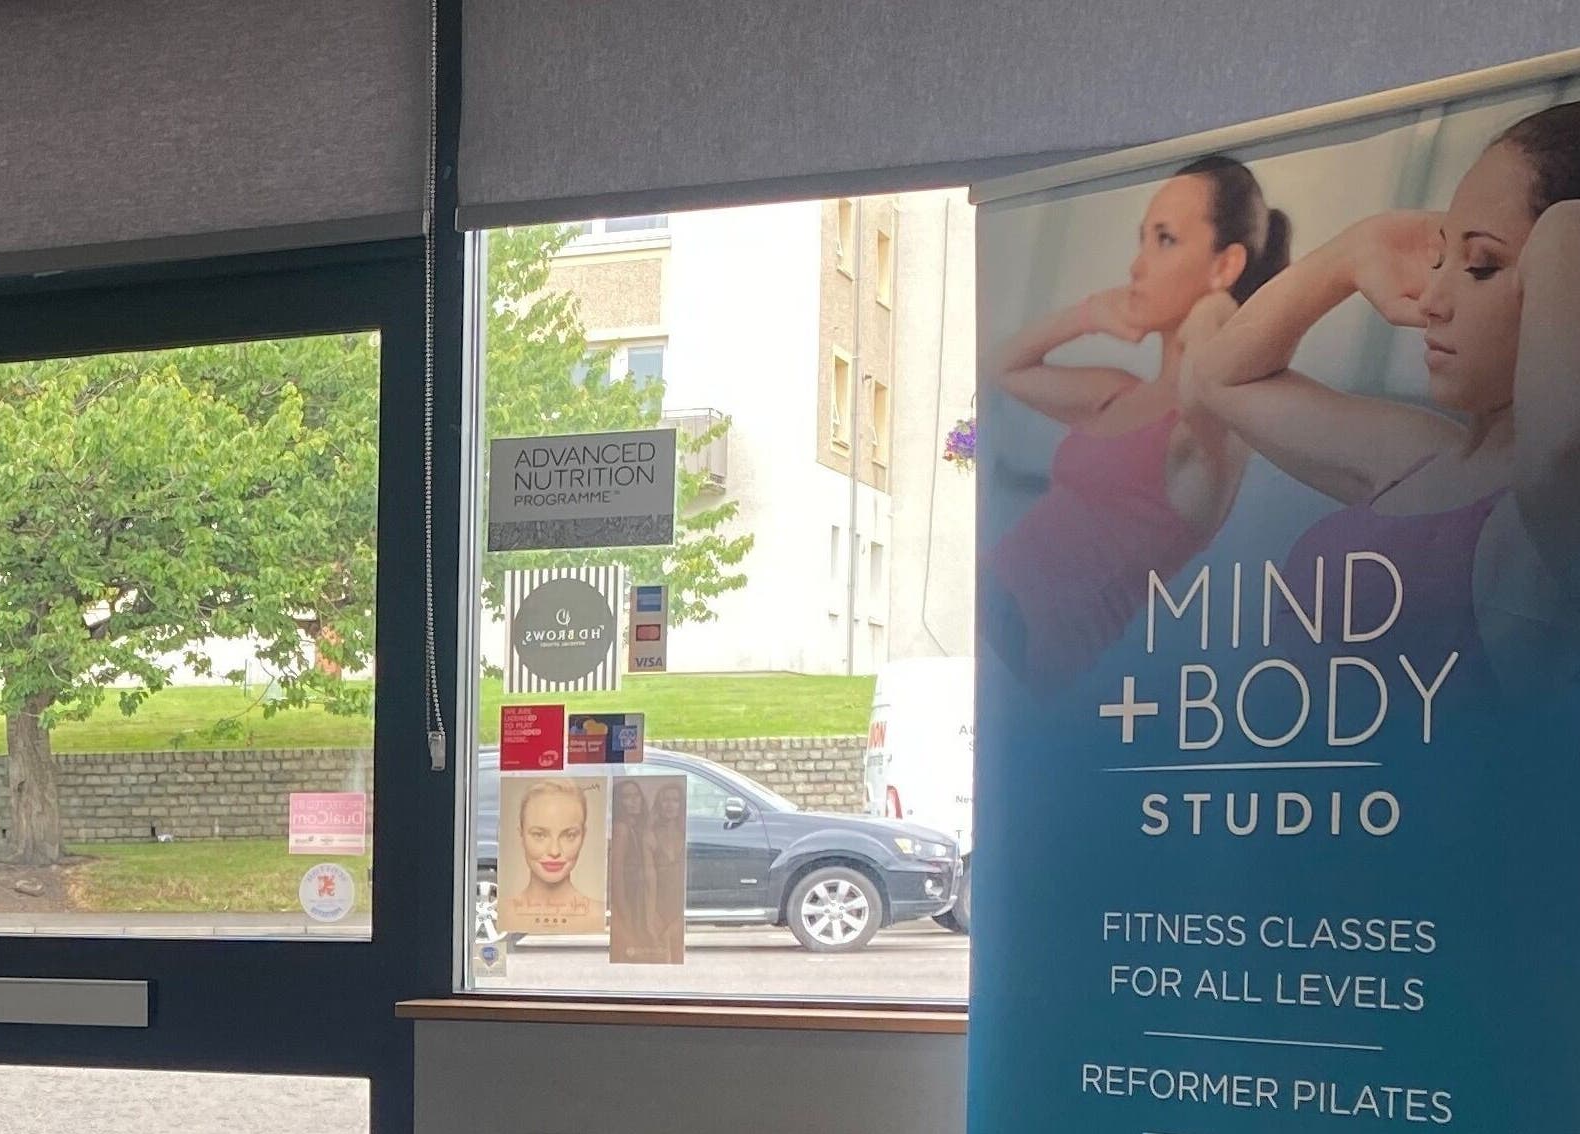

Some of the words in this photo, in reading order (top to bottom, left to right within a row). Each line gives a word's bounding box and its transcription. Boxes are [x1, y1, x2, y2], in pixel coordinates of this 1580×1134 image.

[514, 442, 656, 469] ADVANCED
[514, 465, 654, 491] NUTRITION
[1147, 551, 1405, 654] MIND
[636, 657, 663, 667] VISA
[1140, 791, 1401, 837] STUDIO
[1103, 911, 1246, 947] FITNESS
[1259, 916, 1437, 955] CLASSES
[1110, 965, 1182, 998] FOR
[1193, 969, 1262, 1003] ALL
[1276, 974, 1425, 1012] LEVELS
[1081, 1063, 1279, 1110] REFORMER
[1293, 1079, 1453, 1125] PILATES
